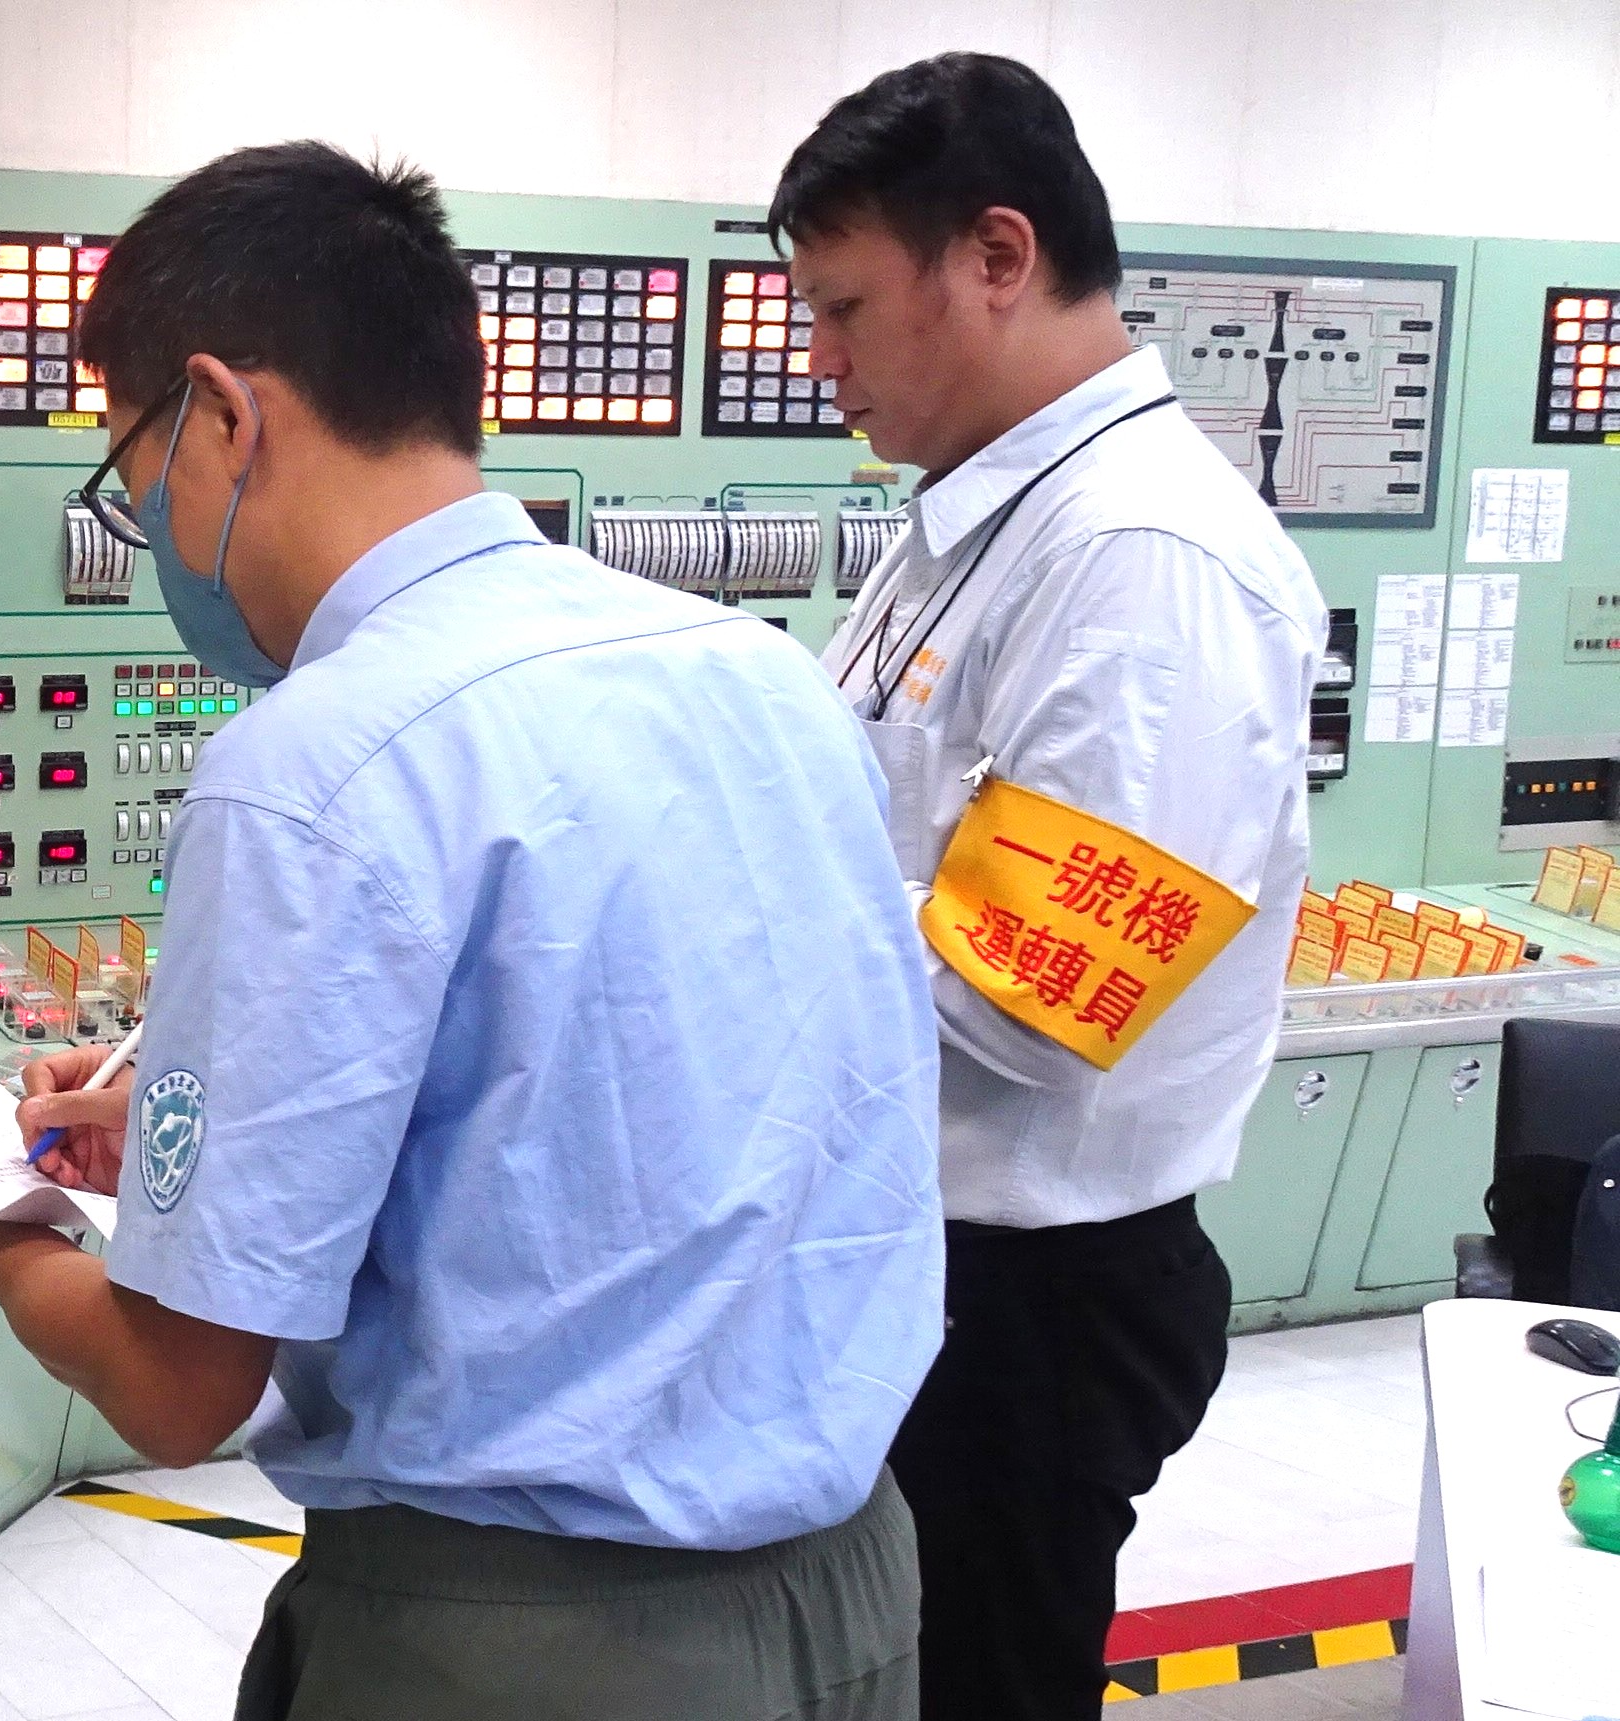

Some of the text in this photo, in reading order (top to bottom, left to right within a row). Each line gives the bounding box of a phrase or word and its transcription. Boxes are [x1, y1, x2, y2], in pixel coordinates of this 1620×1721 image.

[992, 836, 1203, 965] 一號機
[954, 899, 1148, 1044] 運轉員
